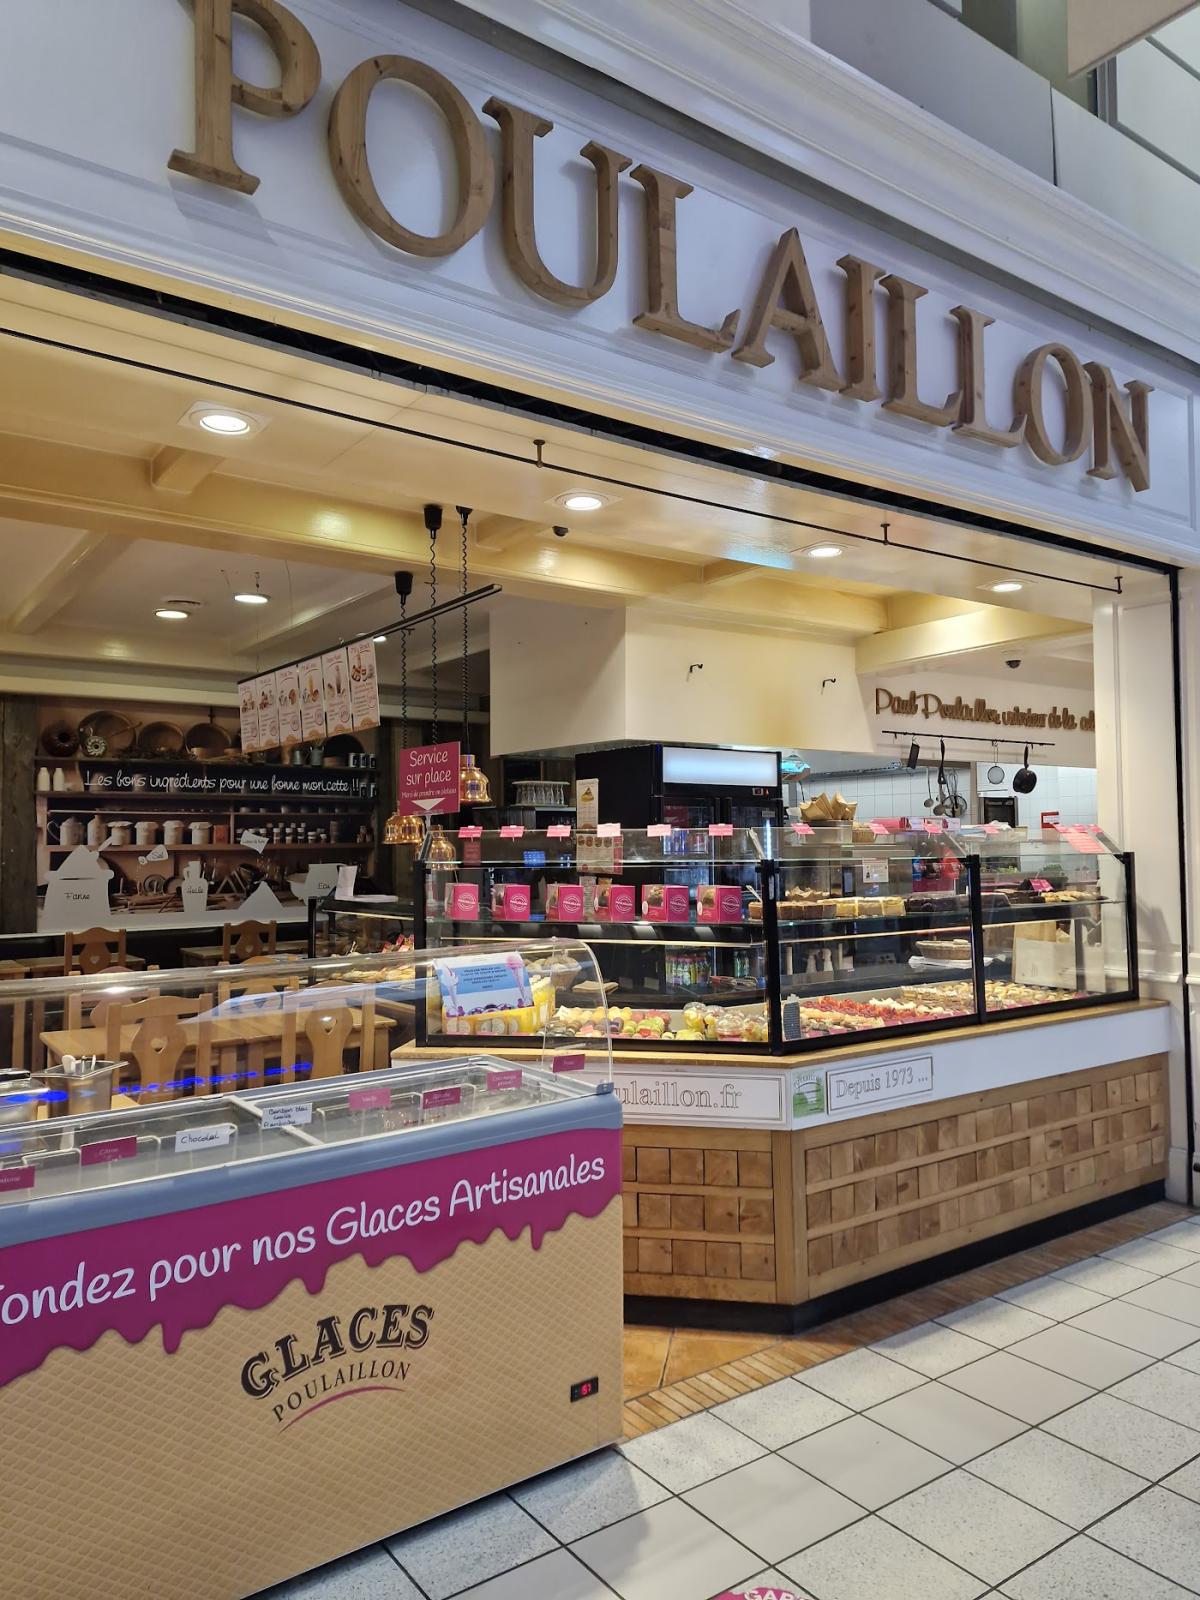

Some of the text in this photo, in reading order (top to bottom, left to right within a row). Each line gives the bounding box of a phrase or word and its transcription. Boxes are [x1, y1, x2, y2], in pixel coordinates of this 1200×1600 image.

[168, 0, 1154, 492] POULAILLON
[409, 749, 448, 767] Service
[84, 770, 112, 786] Les
[116, 769, 146, 788] bons
[149, 773, 216, 793] ingrédients
[219, 777, 246, 793] pour
[249, 779, 269, 790] une
[271, 774, 300, 791] bonne
[406, 767, 452, 788] sur place
[614, 1080, 742, 1109] ulaillon.fr
[836, 1073, 881, 1100] Depuis
[885, 1067, 914, 1088] 1973
[0, 1154, 606, 1325] ondez pour nos Glaces Artisanales
[240, 1304, 435, 1400] GLACES
[271, 1360, 412, 1423] POULAILLON
